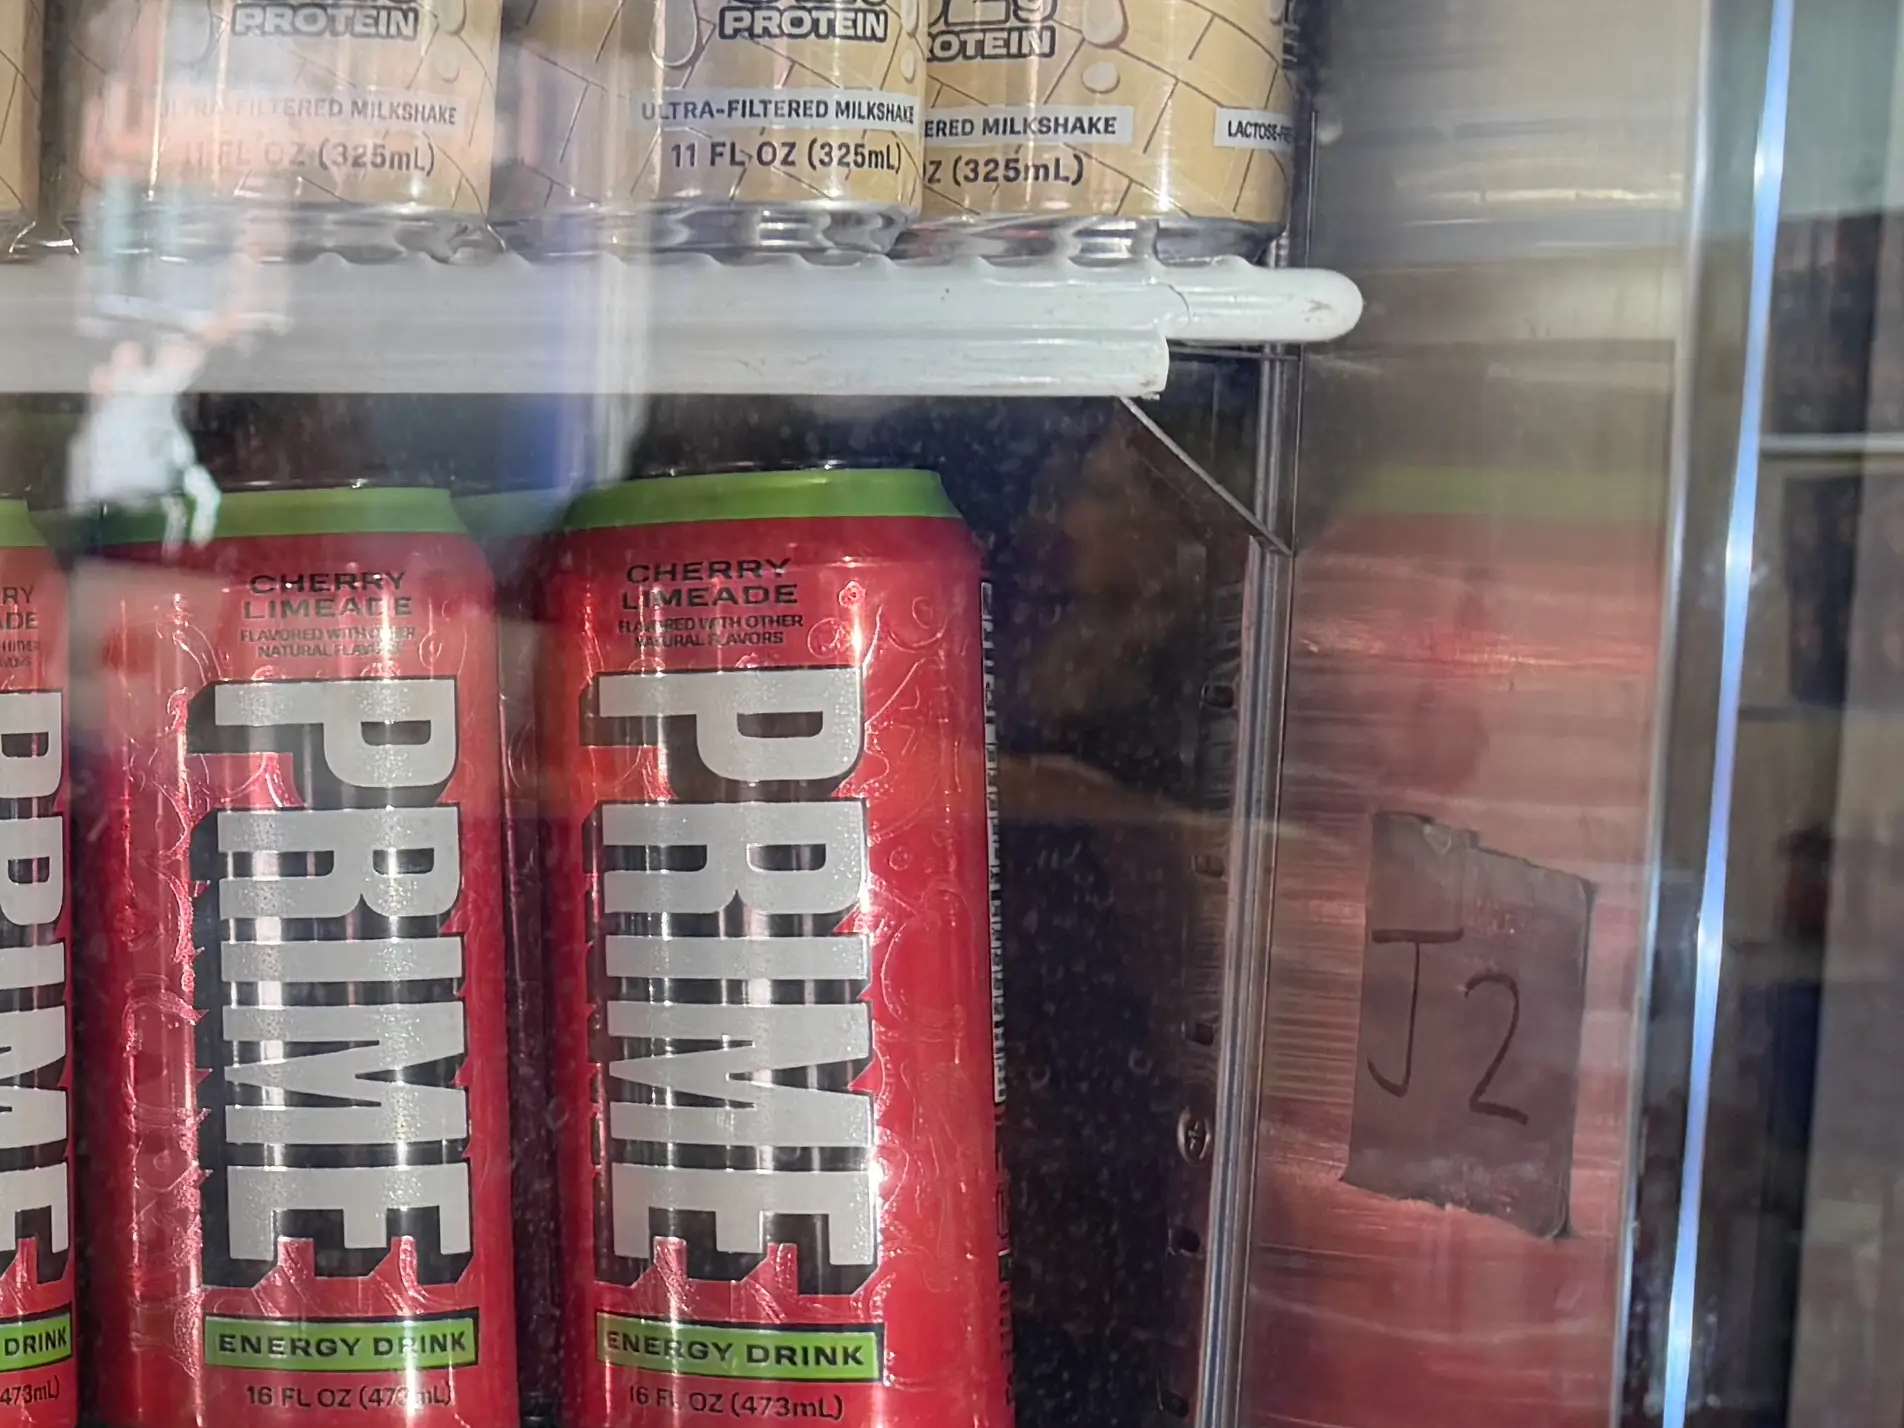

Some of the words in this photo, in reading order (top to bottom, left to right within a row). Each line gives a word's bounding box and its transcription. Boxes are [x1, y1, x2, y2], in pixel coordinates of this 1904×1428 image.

[719, 6, 890, 42] PROTEIN
[626, 556, 792, 584] CHERRY
[621, 584, 798, 611] LIMEADE
[212, 678, 475, 1275] PRIME
[592, 667, 882, 1287] PRIME
[1367, 928, 1529, 1125] J2
[218, 1334, 360, 1358] ENERGY
[373, 1330, 468, 1356] DRINK
[607, 1335, 734, 1364] ENERGY
[745, 1340, 865, 1367] DRINK
